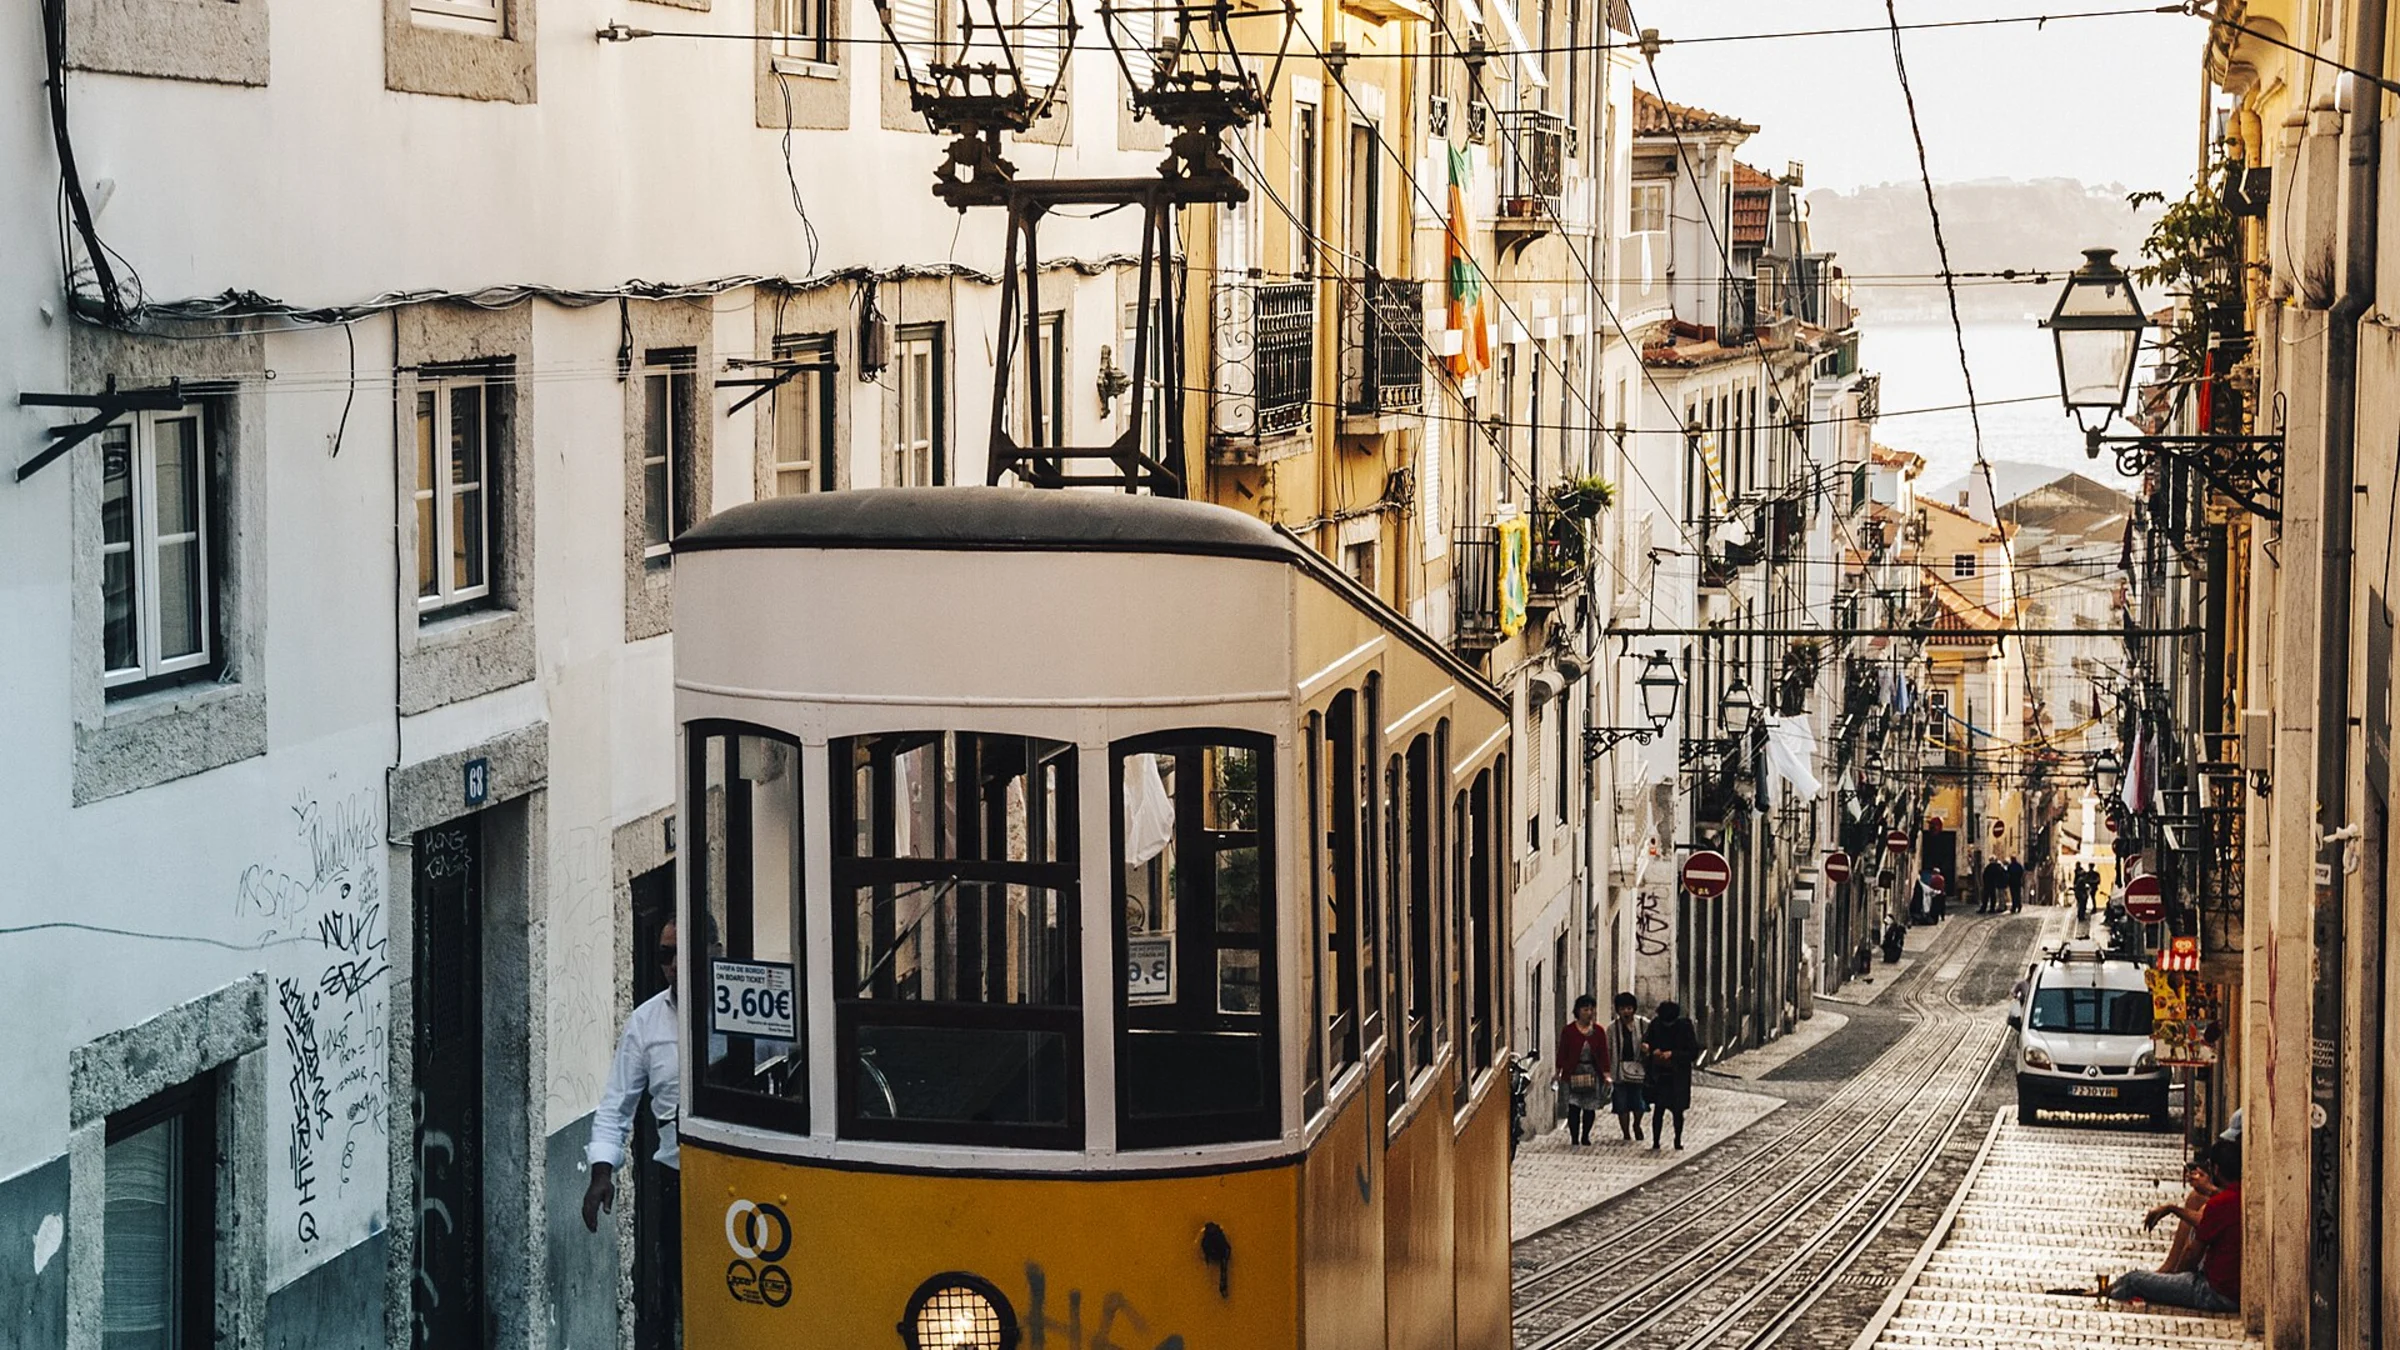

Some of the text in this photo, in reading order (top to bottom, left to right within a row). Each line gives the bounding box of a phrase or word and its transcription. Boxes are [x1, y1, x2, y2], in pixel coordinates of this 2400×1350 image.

[469, 765, 484, 798] 68
[725, 974, 746, 982] BOARD
[717, 985, 790, 1020] 3,60€
